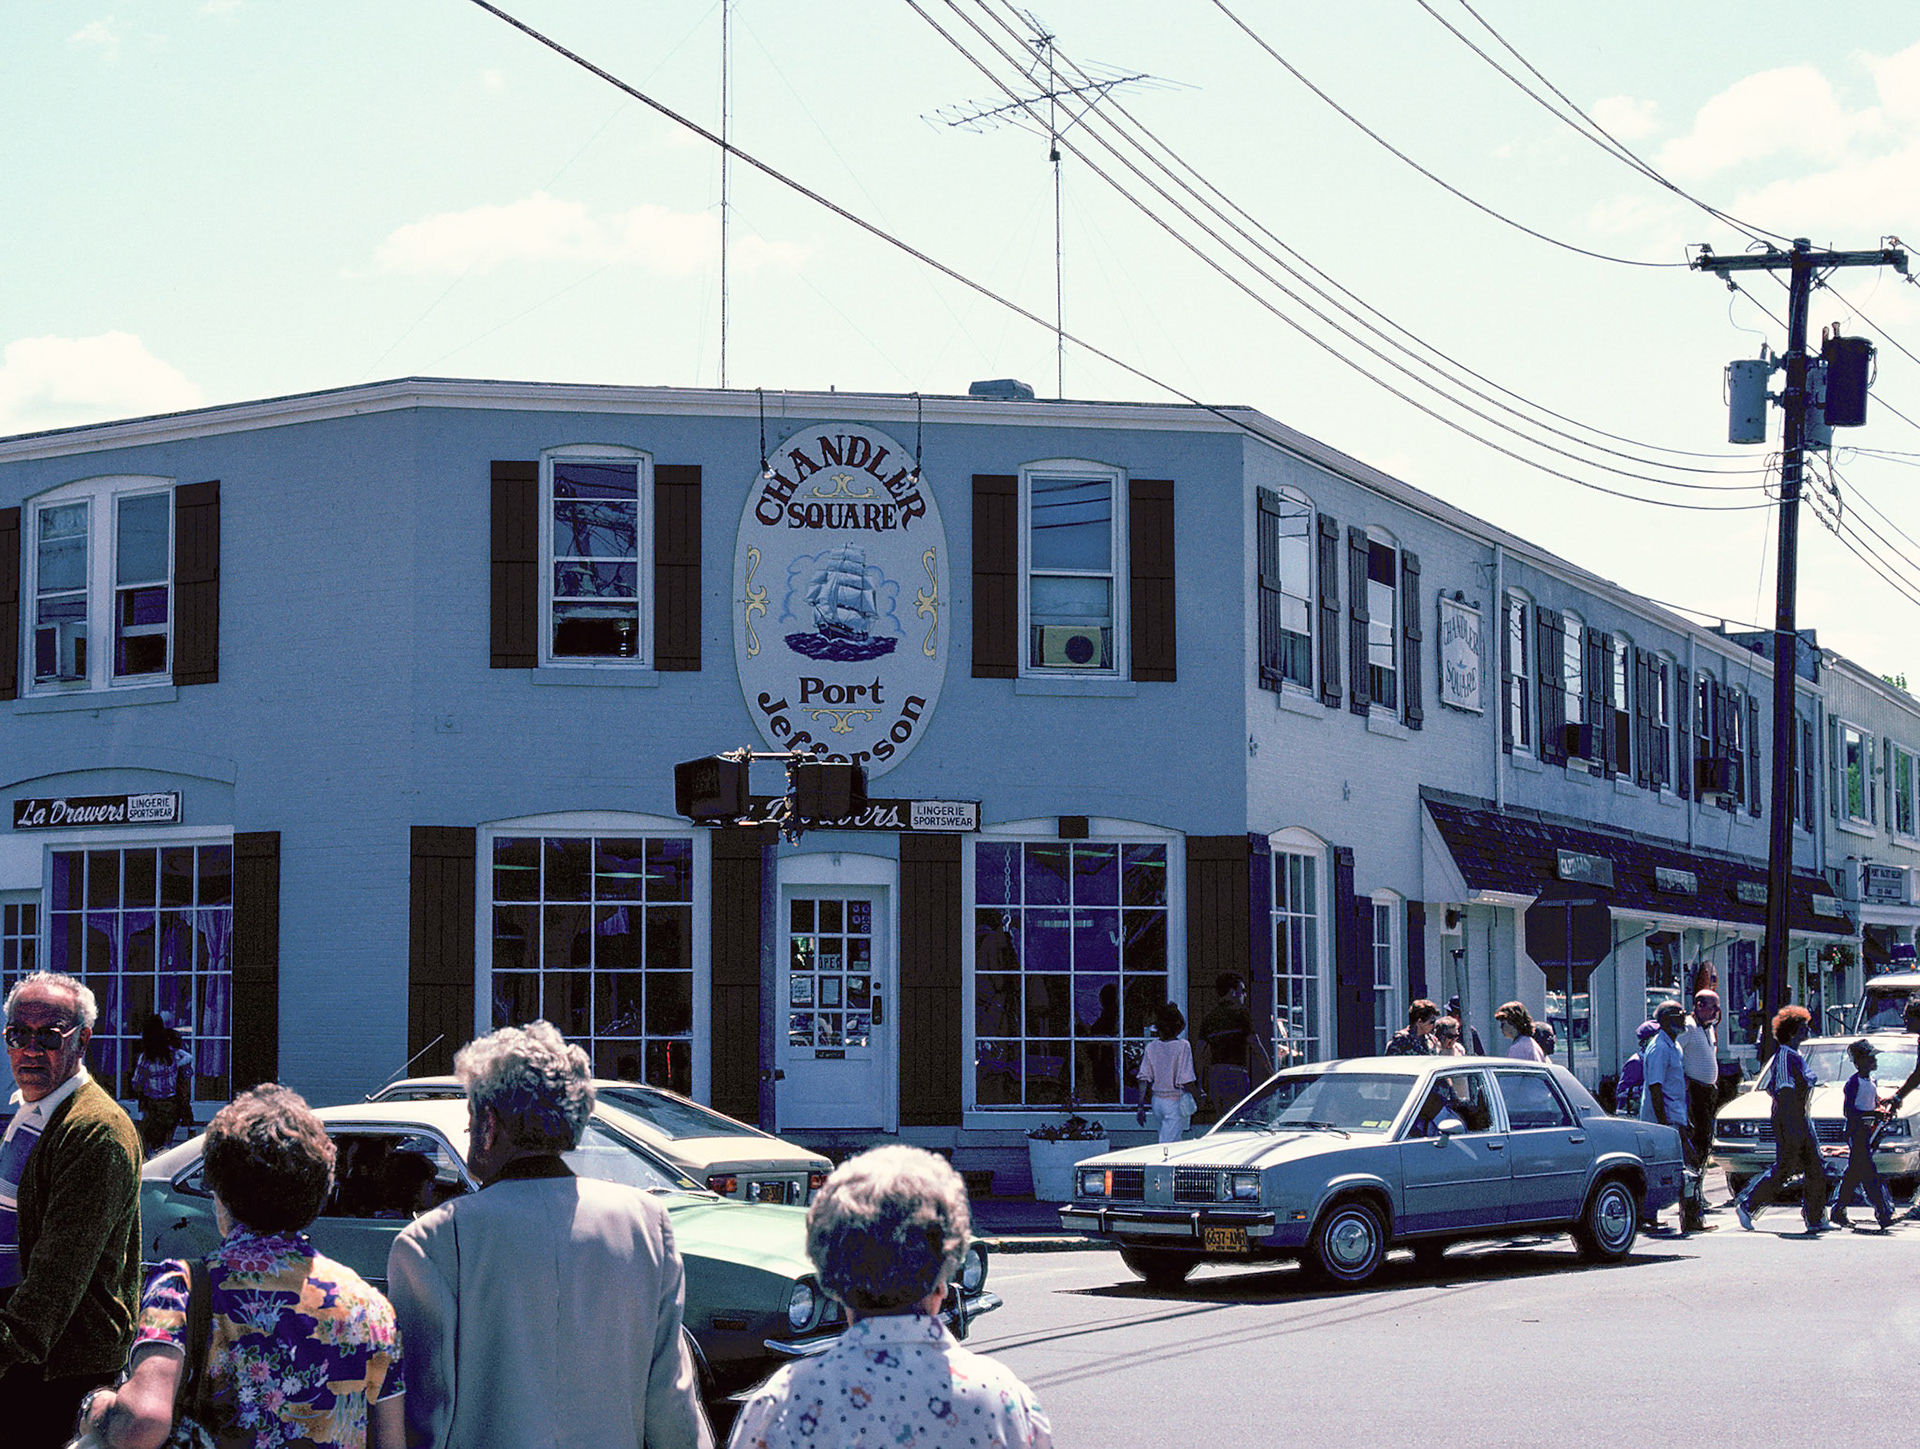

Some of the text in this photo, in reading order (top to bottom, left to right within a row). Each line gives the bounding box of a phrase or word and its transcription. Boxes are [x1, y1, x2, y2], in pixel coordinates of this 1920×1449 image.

[755, 434, 926, 532] CHANDLER
[787, 503, 897, 532] SQUARE
[799, 676, 885, 704] Port
[17, 799, 125, 826] La Drawers
[130, 797, 170, 809] LINGERIE
[917, 805, 964, 816] LINGERIE
[129, 807, 173, 819] SPORTSWEAR
[913, 816, 973, 827] SPORTSWEAR
